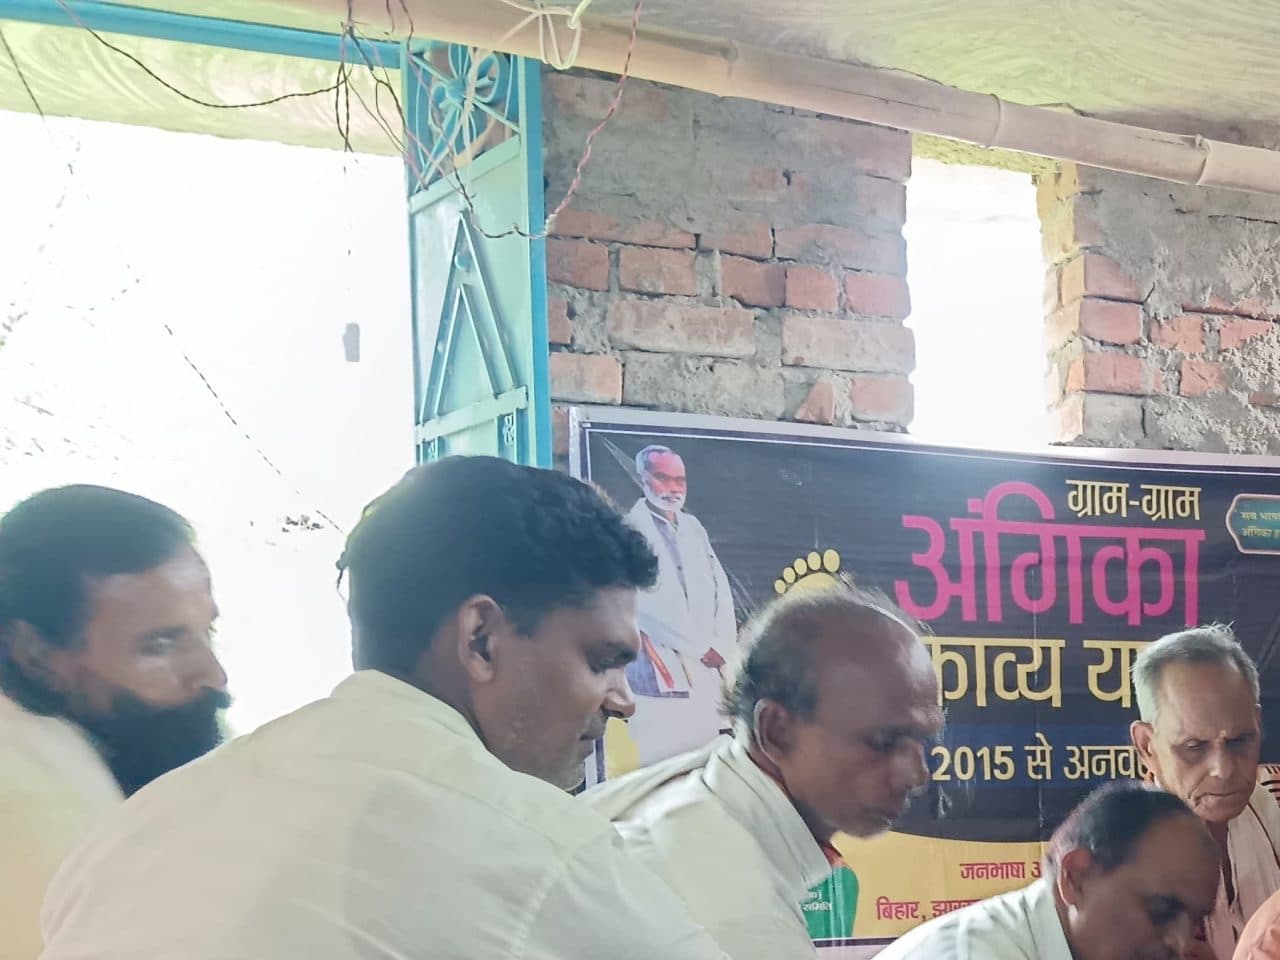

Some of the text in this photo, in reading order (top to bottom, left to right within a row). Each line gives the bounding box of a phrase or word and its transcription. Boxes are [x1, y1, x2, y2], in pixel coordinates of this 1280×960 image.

[1065, 479, 1202, 521] ग्राम-ग्राम
[894, 481, 1206, 626] अंगिका
[930, 745, 1016, 781] 2015
[1024, 731, 1052, 780] से
[960, 862, 1026, 881] जनभाषा
[876, 896, 926, 921] बिहार,
